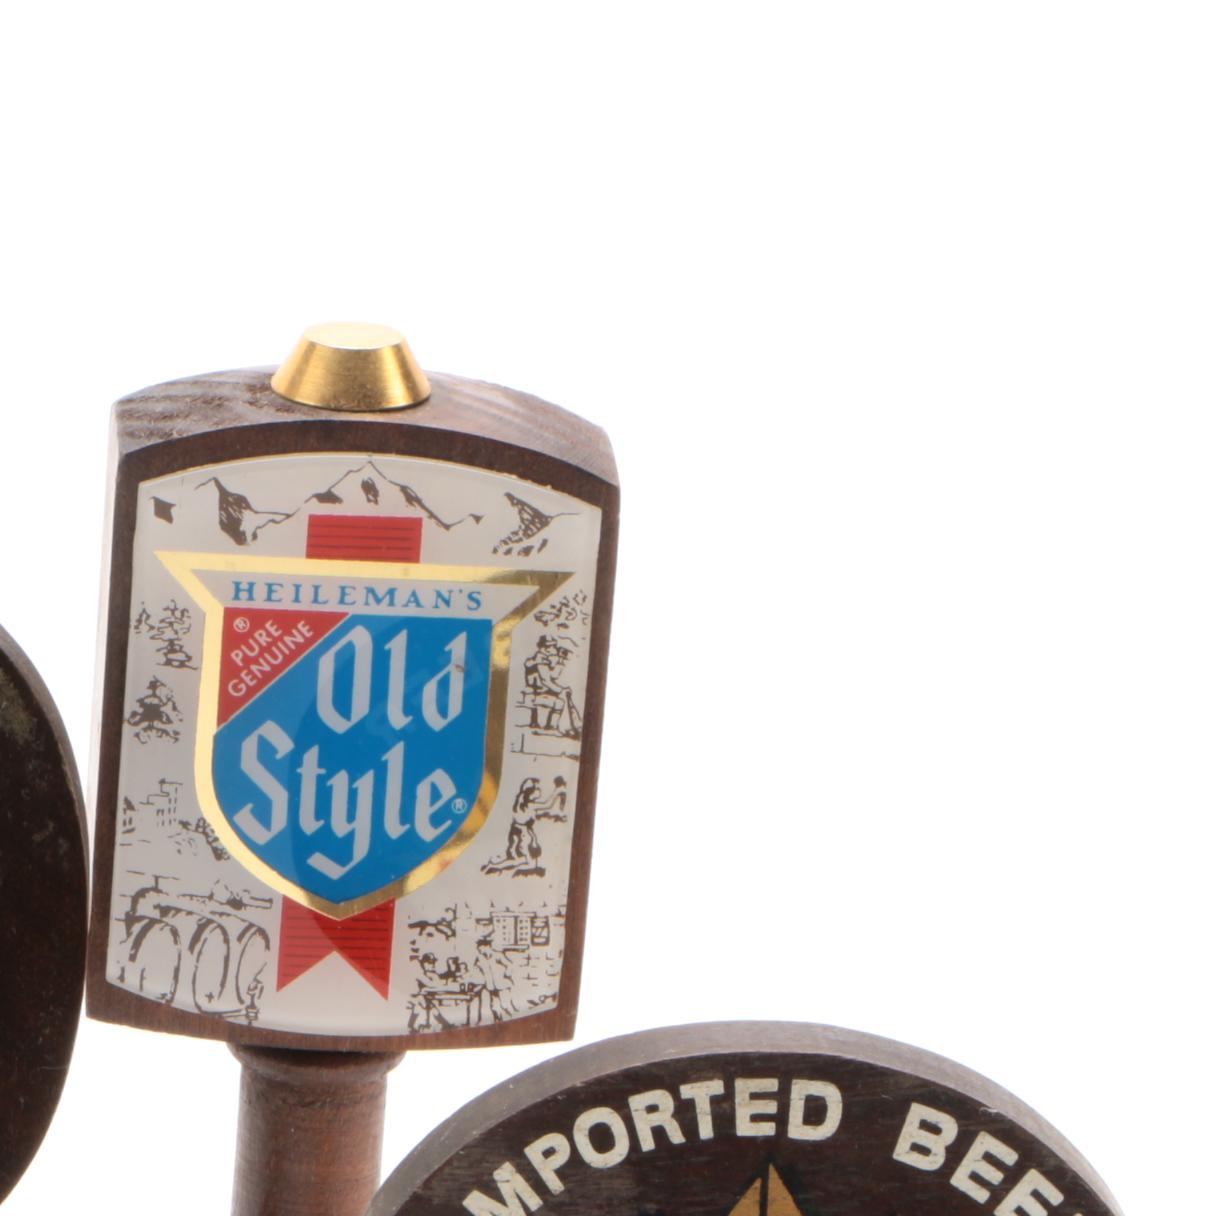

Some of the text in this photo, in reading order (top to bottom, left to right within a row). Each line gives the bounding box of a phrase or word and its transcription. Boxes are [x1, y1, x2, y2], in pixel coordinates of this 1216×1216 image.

[231, 580, 483, 612] HEILEMAN'S
[227, 620, 314, 697] GENUINE
[230, 619, 282, 667] PURE
[316, 624, 468, 734] Old
